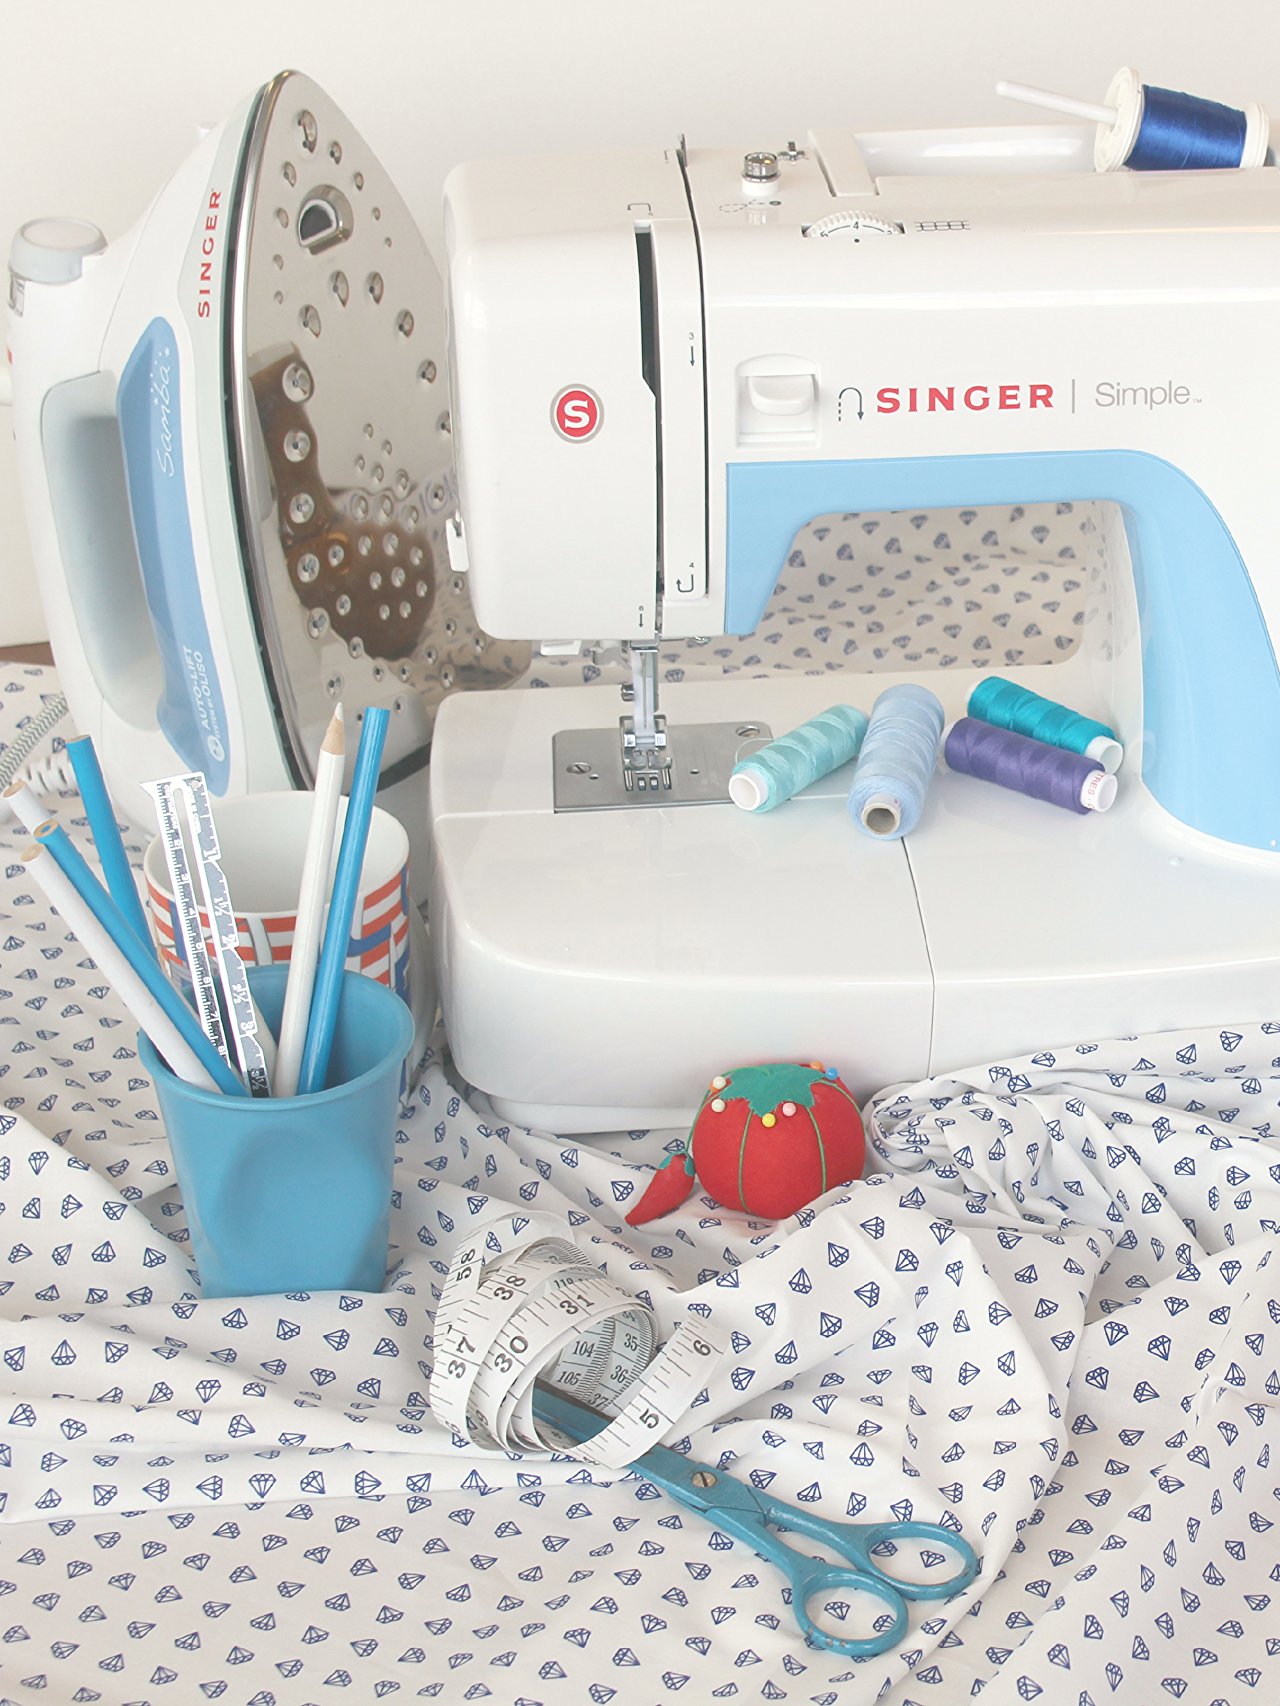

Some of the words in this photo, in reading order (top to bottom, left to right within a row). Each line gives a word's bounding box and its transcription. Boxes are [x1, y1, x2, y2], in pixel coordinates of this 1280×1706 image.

[853, 221, 860, 230] 4
[197, 190, 222, 318] SINGER
[688, 332, 695, 341] 3
[876, 383, 1055, 414] SINGER
[154, 365, 175, 478] Samba
[563, 399, 590, 429] S
[689, 561, 695, 569] 4
[193, 651, 211, 697] OLISO
[183, 645, 211, 731] AUTO-LIFT
[456, 1248, 476, 1282] 58
[493, 1275, 527, 1301] 38
[559, 1294, 596, 1315] 31
[571, 1340, 595, 1358] 104
[623, 1332, 639, 1352] 35
[693, 1339, 712, 1356] 6
[447, 1335, 476, 1379] 37
[494, 1335, 529, 1374] 30
[556, 1370, 581, 1386] 105
[610, 1364, 628, 1384] 36
[588, 1393, 609, 1411] 37
[639, 1408, 660, 1429] 5
